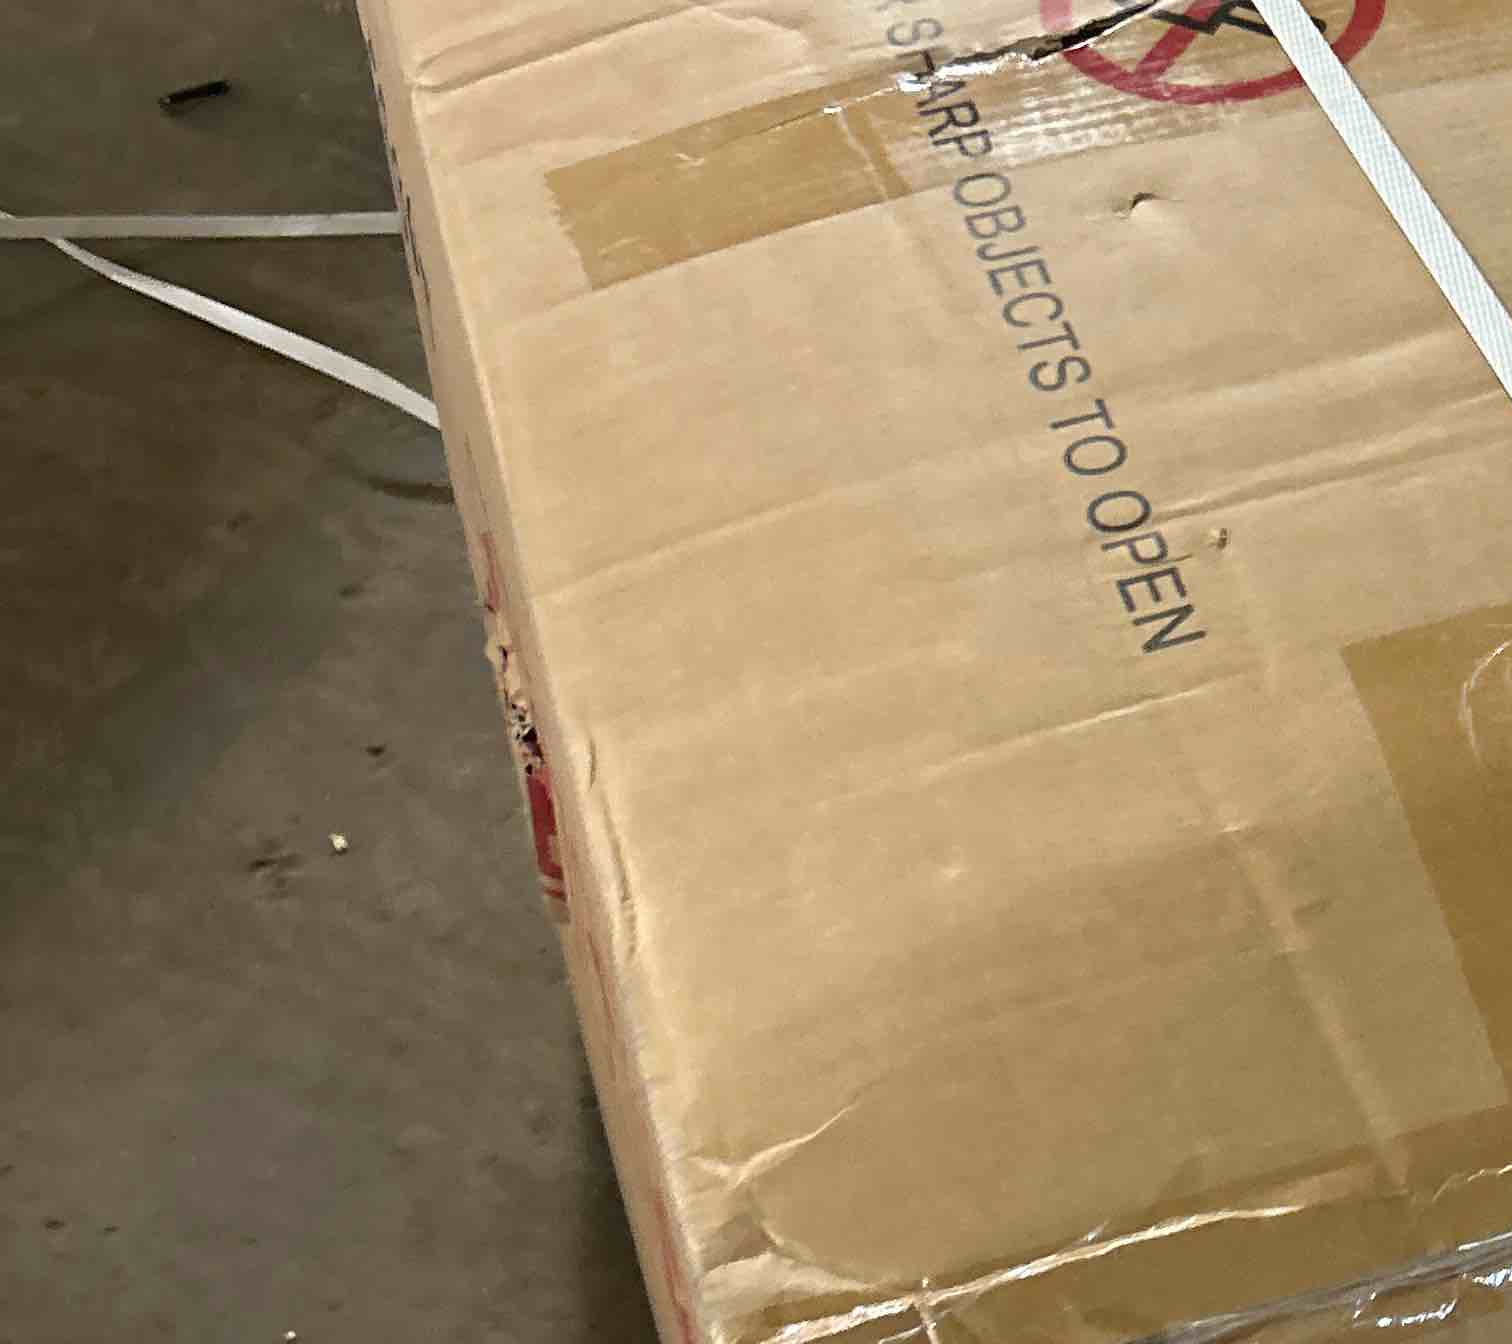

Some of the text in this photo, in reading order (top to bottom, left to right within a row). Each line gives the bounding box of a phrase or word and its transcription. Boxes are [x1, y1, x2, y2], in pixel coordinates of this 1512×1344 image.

[886, 16, 997, 162] SHARP
[952, 172, 1092, 395] OBJECTS
[1049, 398, 1129, 478] TO
[1086, 487, 1207, 656] OPEN
